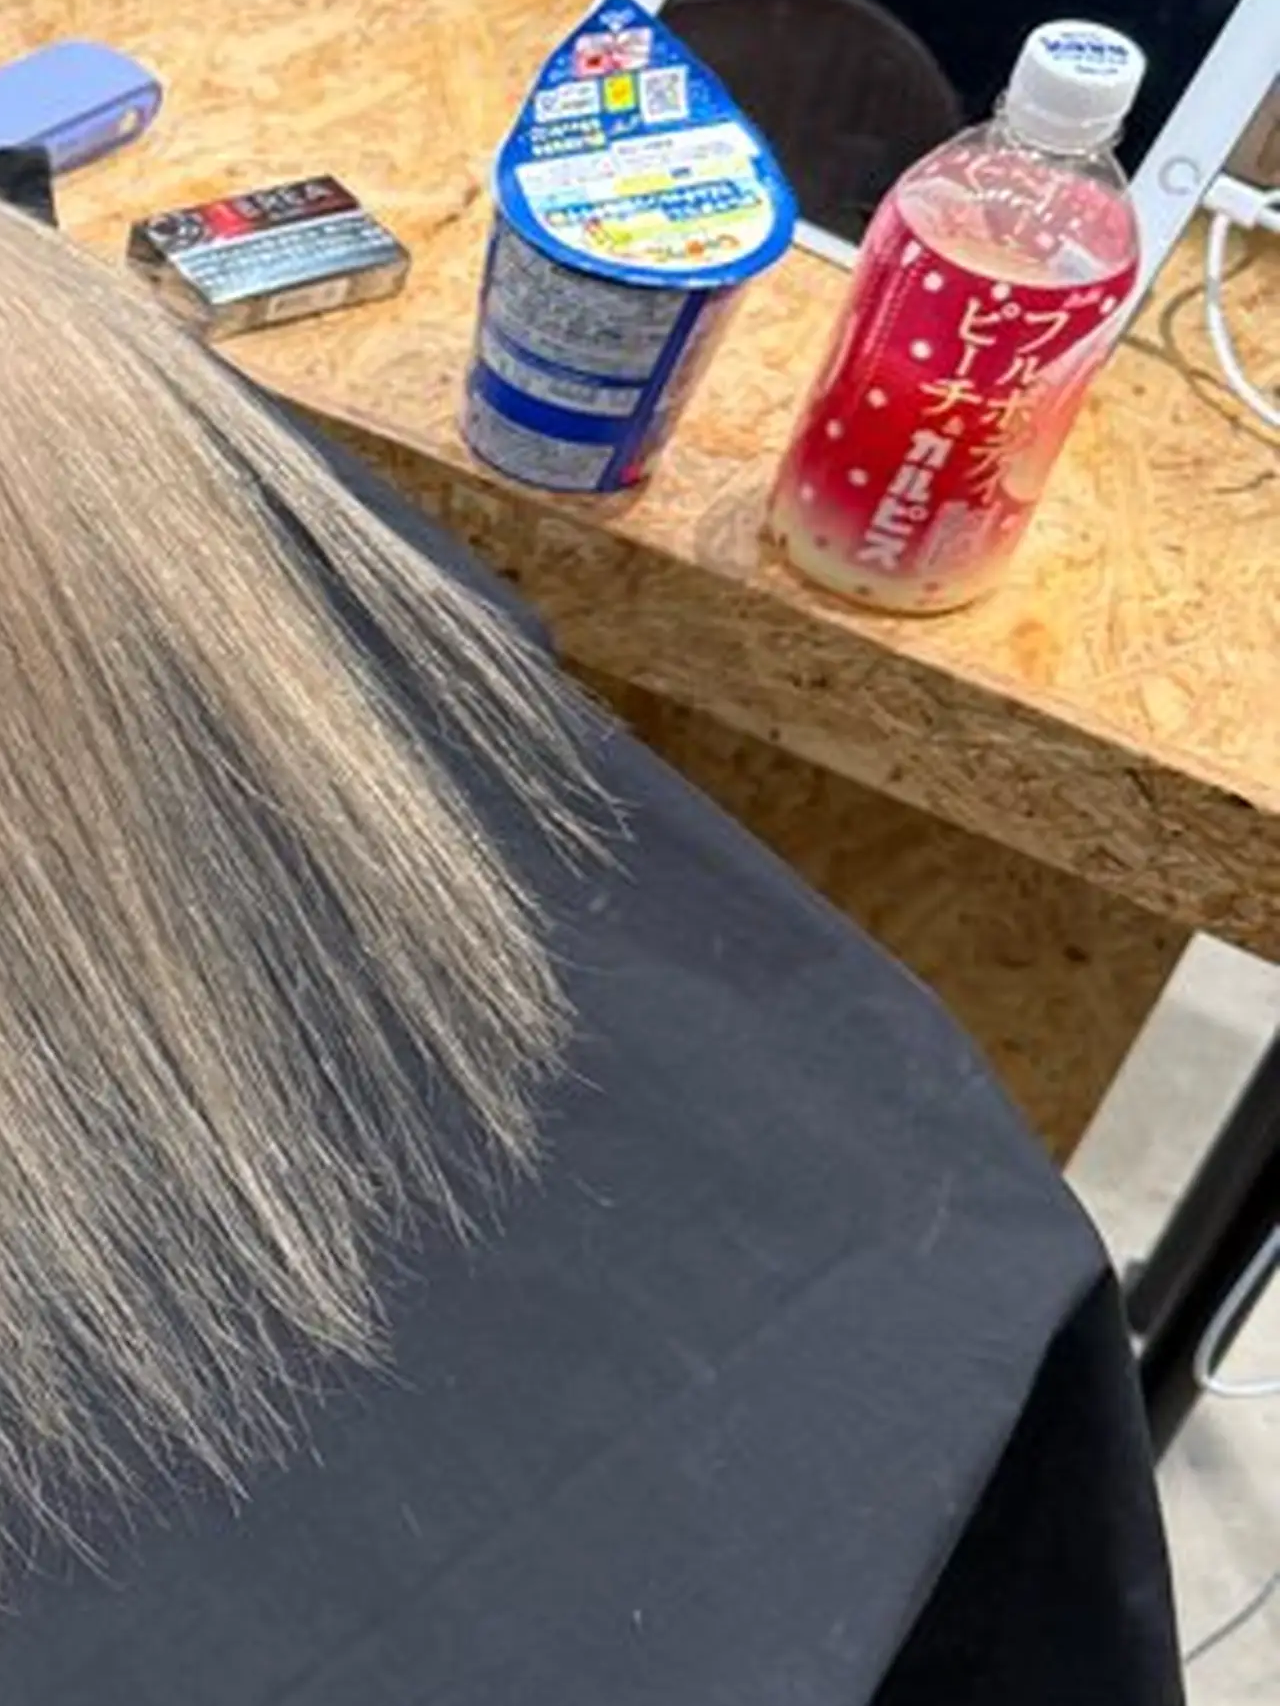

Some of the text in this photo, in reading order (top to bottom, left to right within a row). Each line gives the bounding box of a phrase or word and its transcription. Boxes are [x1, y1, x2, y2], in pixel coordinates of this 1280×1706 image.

[917, 296, 1022, 415] ピーチ
[855, 428, 955, 571] カルピス
